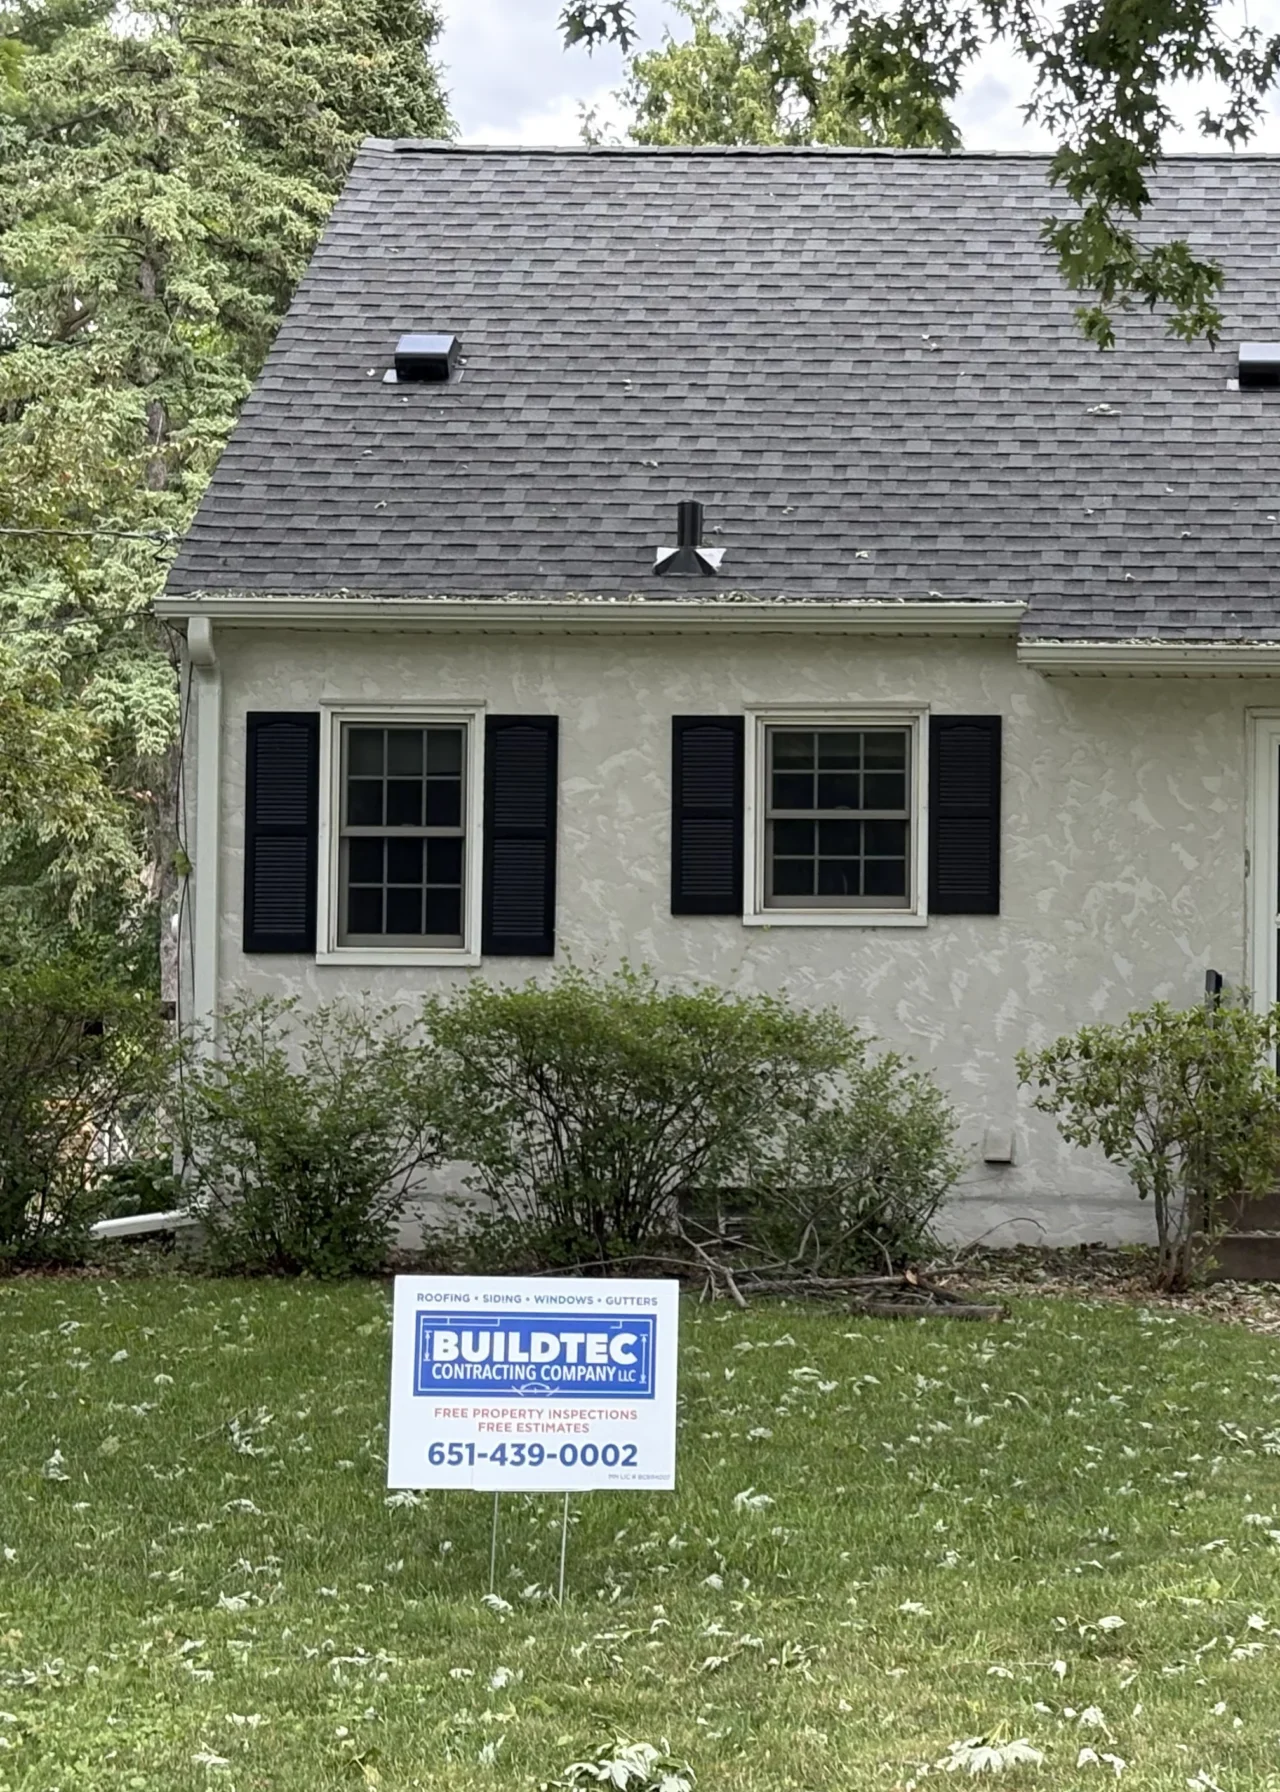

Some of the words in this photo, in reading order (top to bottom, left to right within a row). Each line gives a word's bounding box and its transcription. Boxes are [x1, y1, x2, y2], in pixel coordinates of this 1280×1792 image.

[416, 1293, 471, 1304] ROOFING
[482, 1294, 522, 1304] SIDING
[534, 1295, 594, 1305] WINDOWS
[605, 1296, 658, 1306] GUTTERS
[432, 1330, 638, 1365] BUILDTEC
[431, 1362, 537, 1381] CONTRACTING
[540, 1364, 617, 1382] COMPANY
[618, 1369, 637, 1382] LLC
[434, 1407, 468, 1419] FREE
[472, 1408, 544, 1419] PROPERTY
[548, 1409, 638, 1420] INSPECTIONS
[478, 1422, 512, 1432] FREE
[516, 1422, 590, 1433] ESTIMATES
[428, 1442, 638, 1467] 651-439-0002
